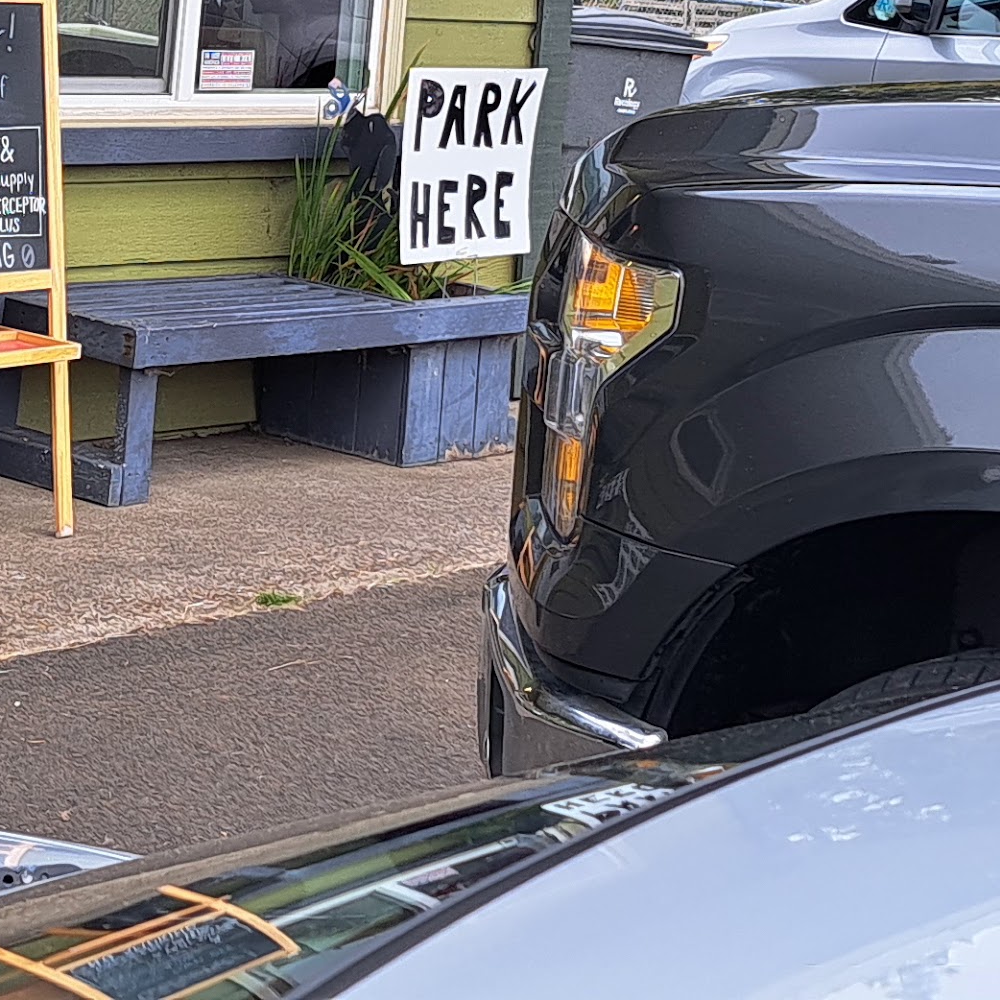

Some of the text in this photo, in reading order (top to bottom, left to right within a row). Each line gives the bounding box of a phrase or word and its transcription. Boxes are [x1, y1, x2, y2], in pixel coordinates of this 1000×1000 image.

[0, 135, 15, 163] &
[414, 77, 538, 152] PARK
[410, 171, 515, 249] HERE
